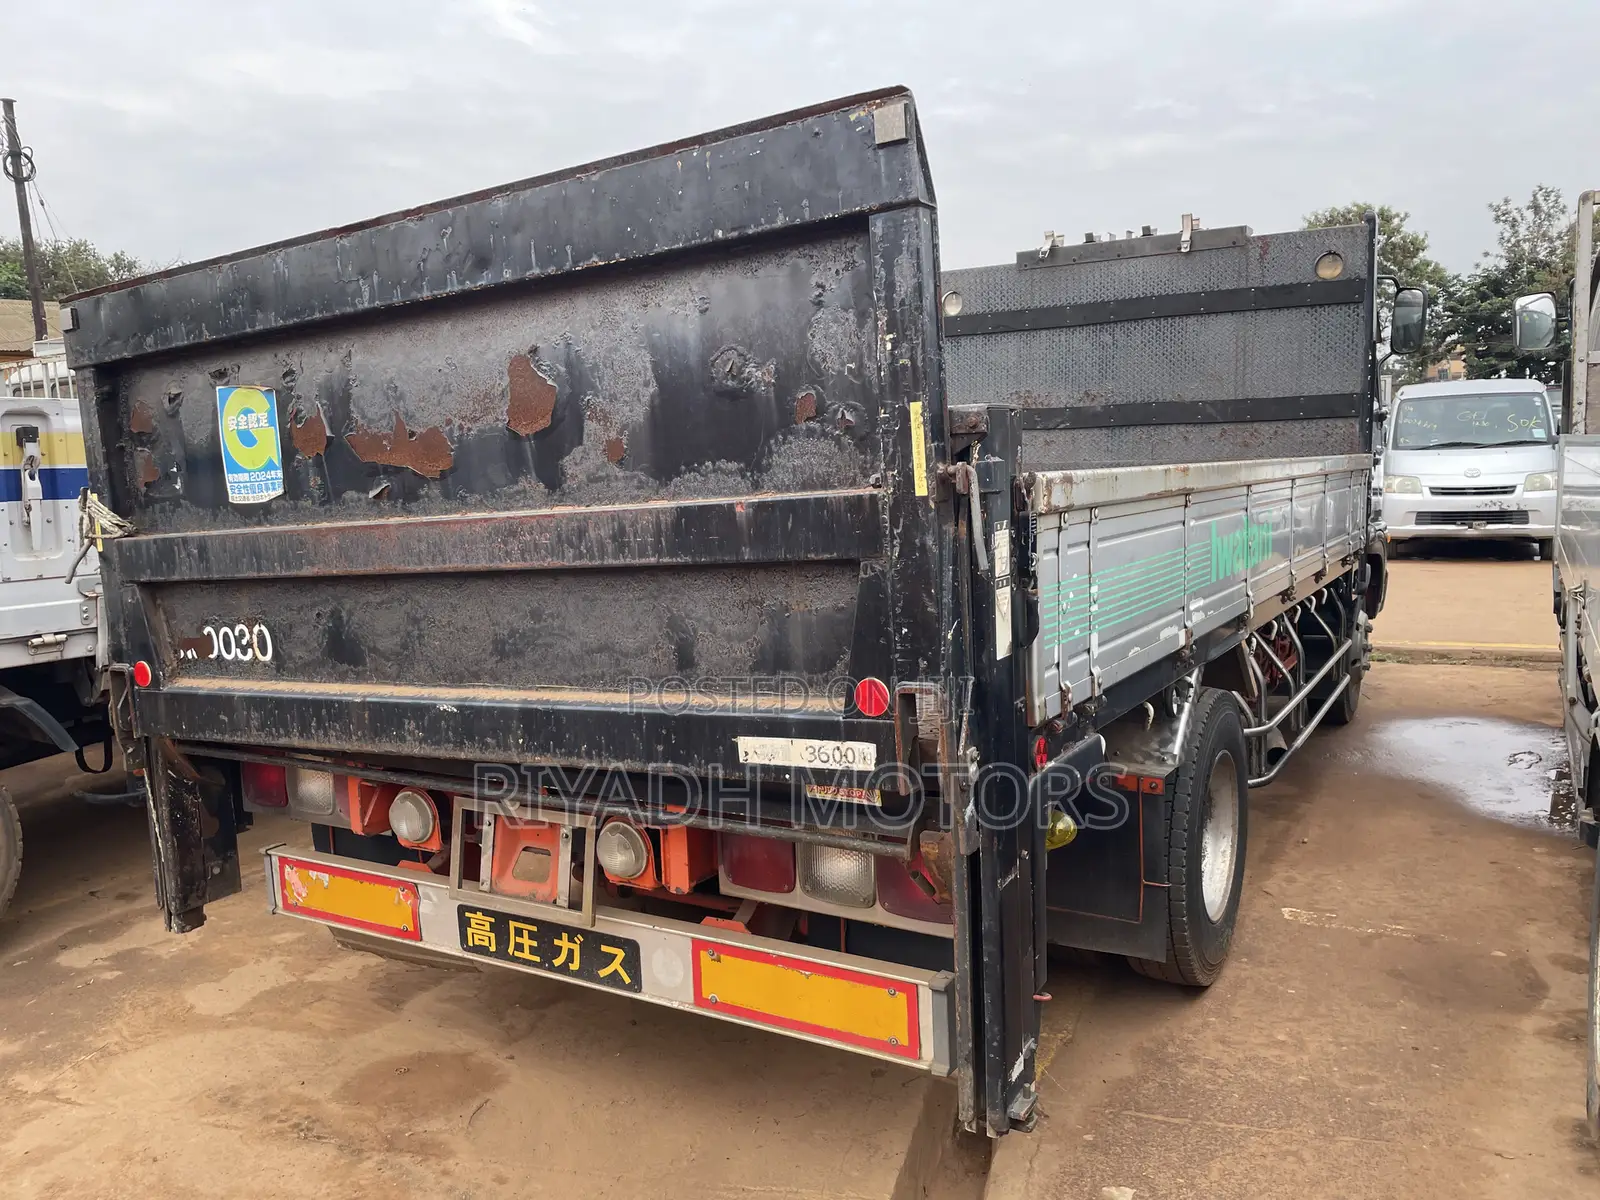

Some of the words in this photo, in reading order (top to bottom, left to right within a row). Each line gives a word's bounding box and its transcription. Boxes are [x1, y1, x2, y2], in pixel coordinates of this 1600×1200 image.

[228, 412, 269, 432] 安全認定
[1211, 510, 1272, 584] Iwatani
[464, 911, 632, 985] 高圧ガス
